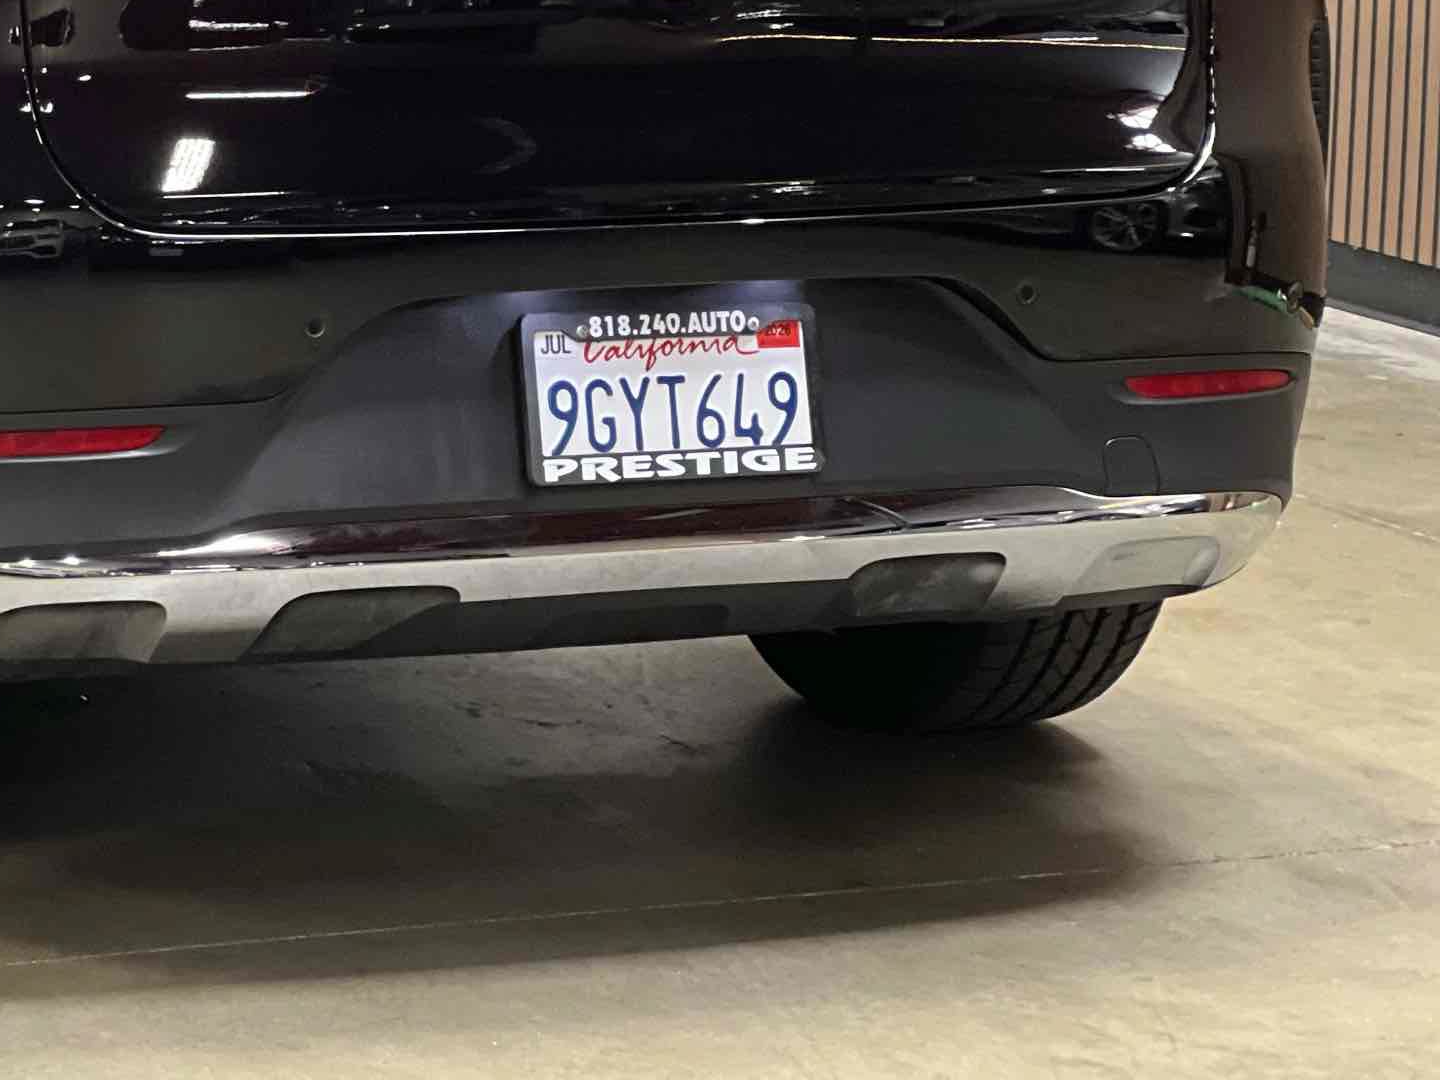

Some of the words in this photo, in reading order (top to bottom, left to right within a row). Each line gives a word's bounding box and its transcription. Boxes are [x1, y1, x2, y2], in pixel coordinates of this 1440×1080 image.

[588, 310, 746, 338] 818.240.AUTO
[540, 334, 572, 355] JUL
[583, 336, 757, 372] California
[547, 370, 799, 457] 9GYT649
[542, 446, 818, 483] PRESTIGE
